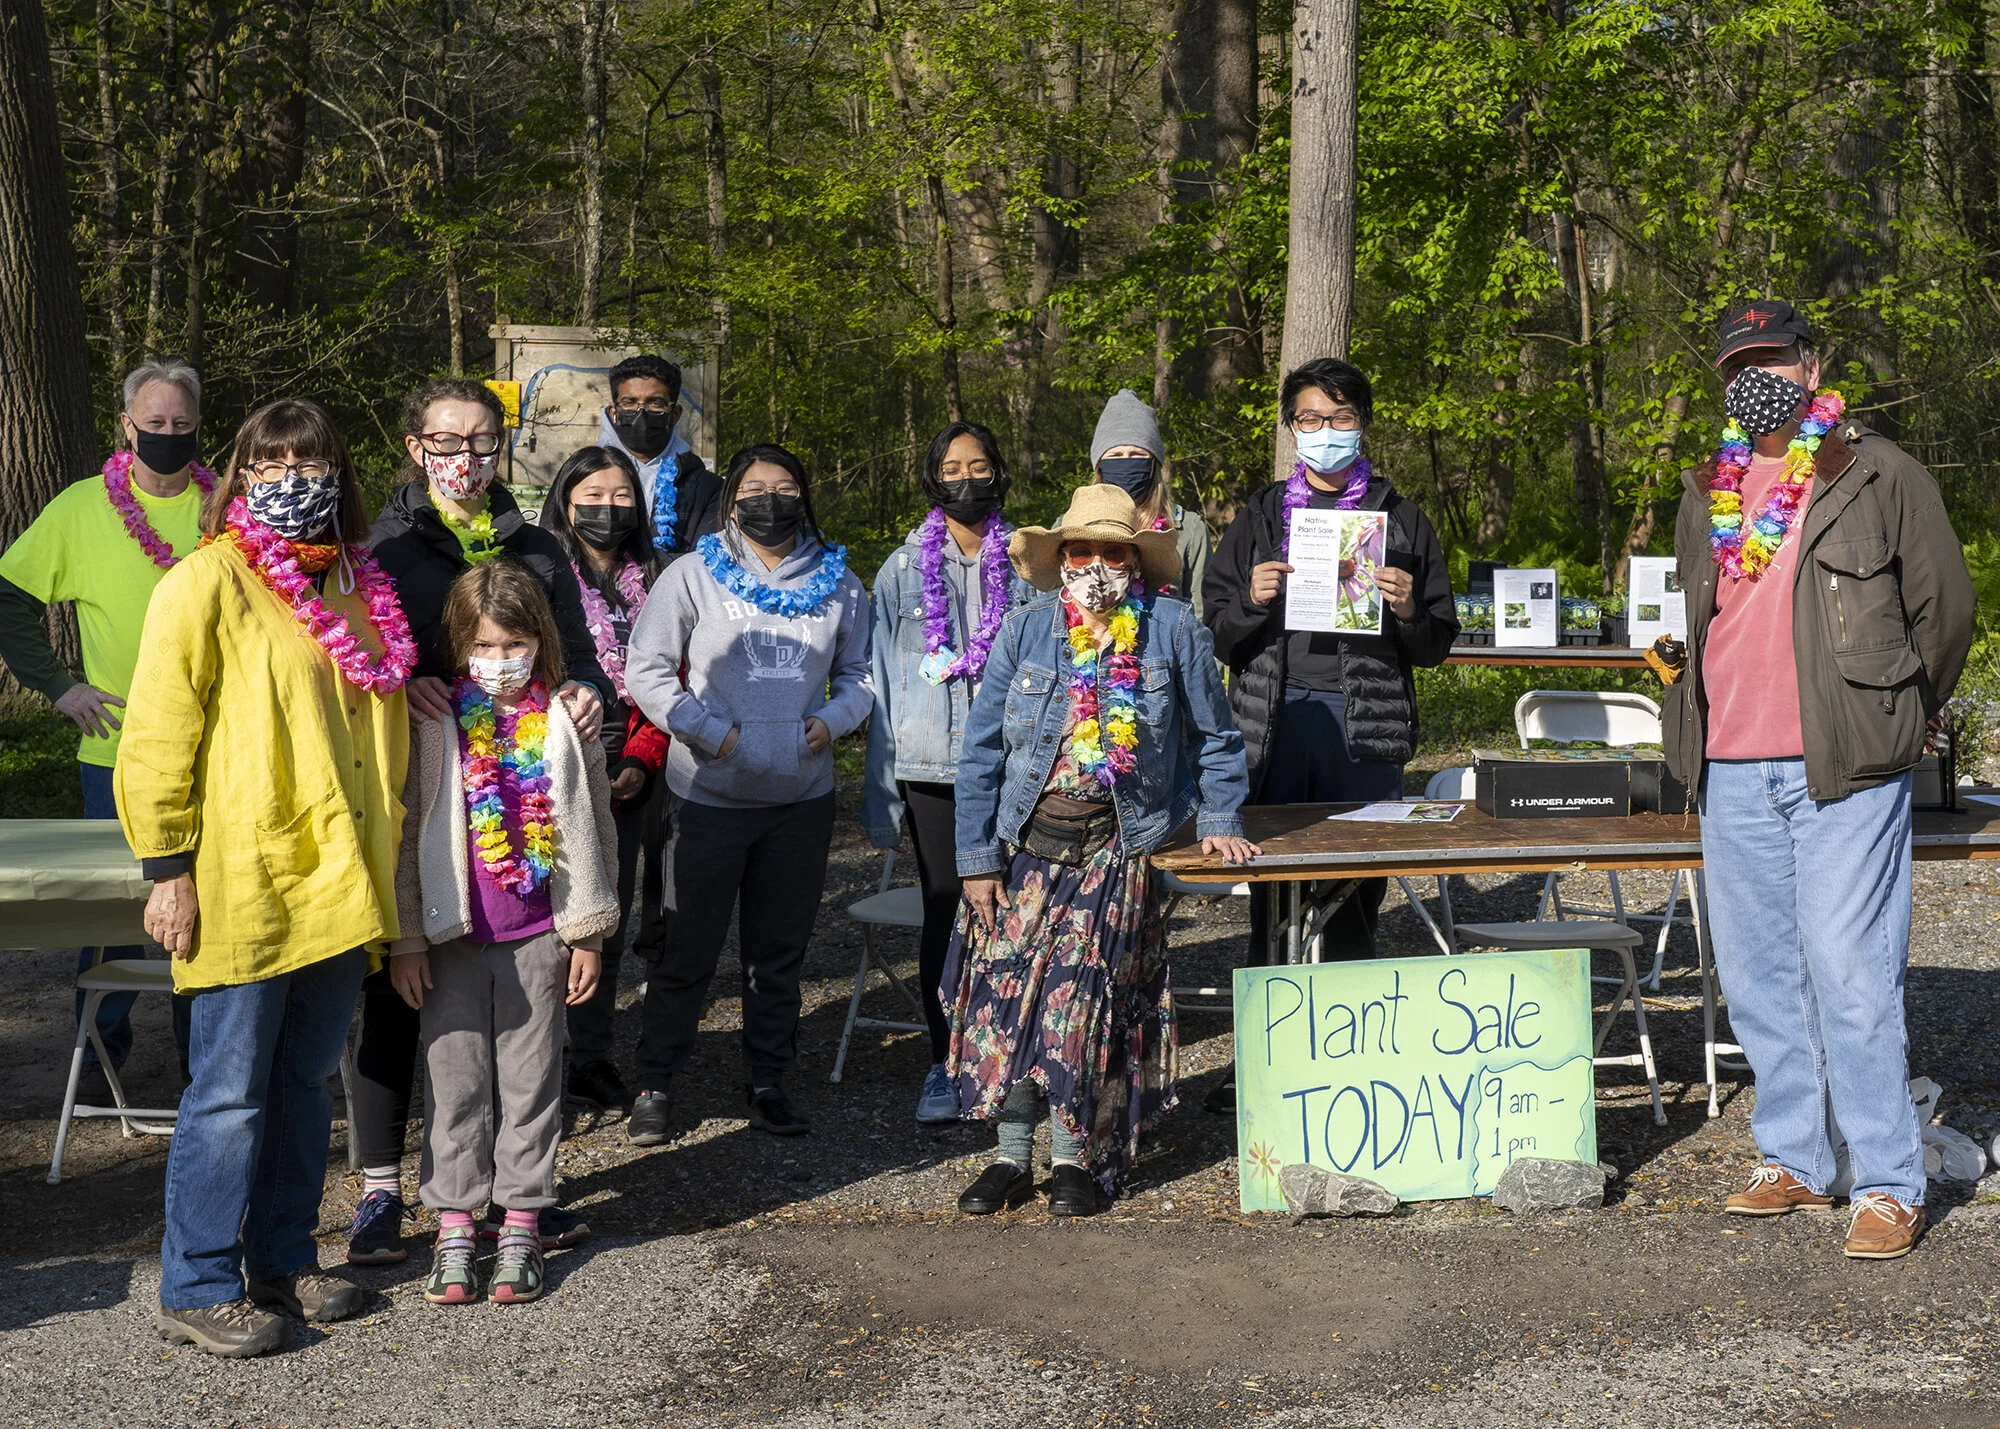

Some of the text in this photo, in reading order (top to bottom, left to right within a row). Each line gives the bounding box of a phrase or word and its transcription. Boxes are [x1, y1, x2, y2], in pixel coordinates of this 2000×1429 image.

[1305, 517, 1328, 525] Native
[1298, 526, 1316, 534] Plant
[761, 669, 791, 677] ATHLETICS
[1525, 798, 1563, 806] UNDER
[1266, 968, 1542, 1067] Plant Sale
[1282, 1074, 1476, 1173] TODAY
